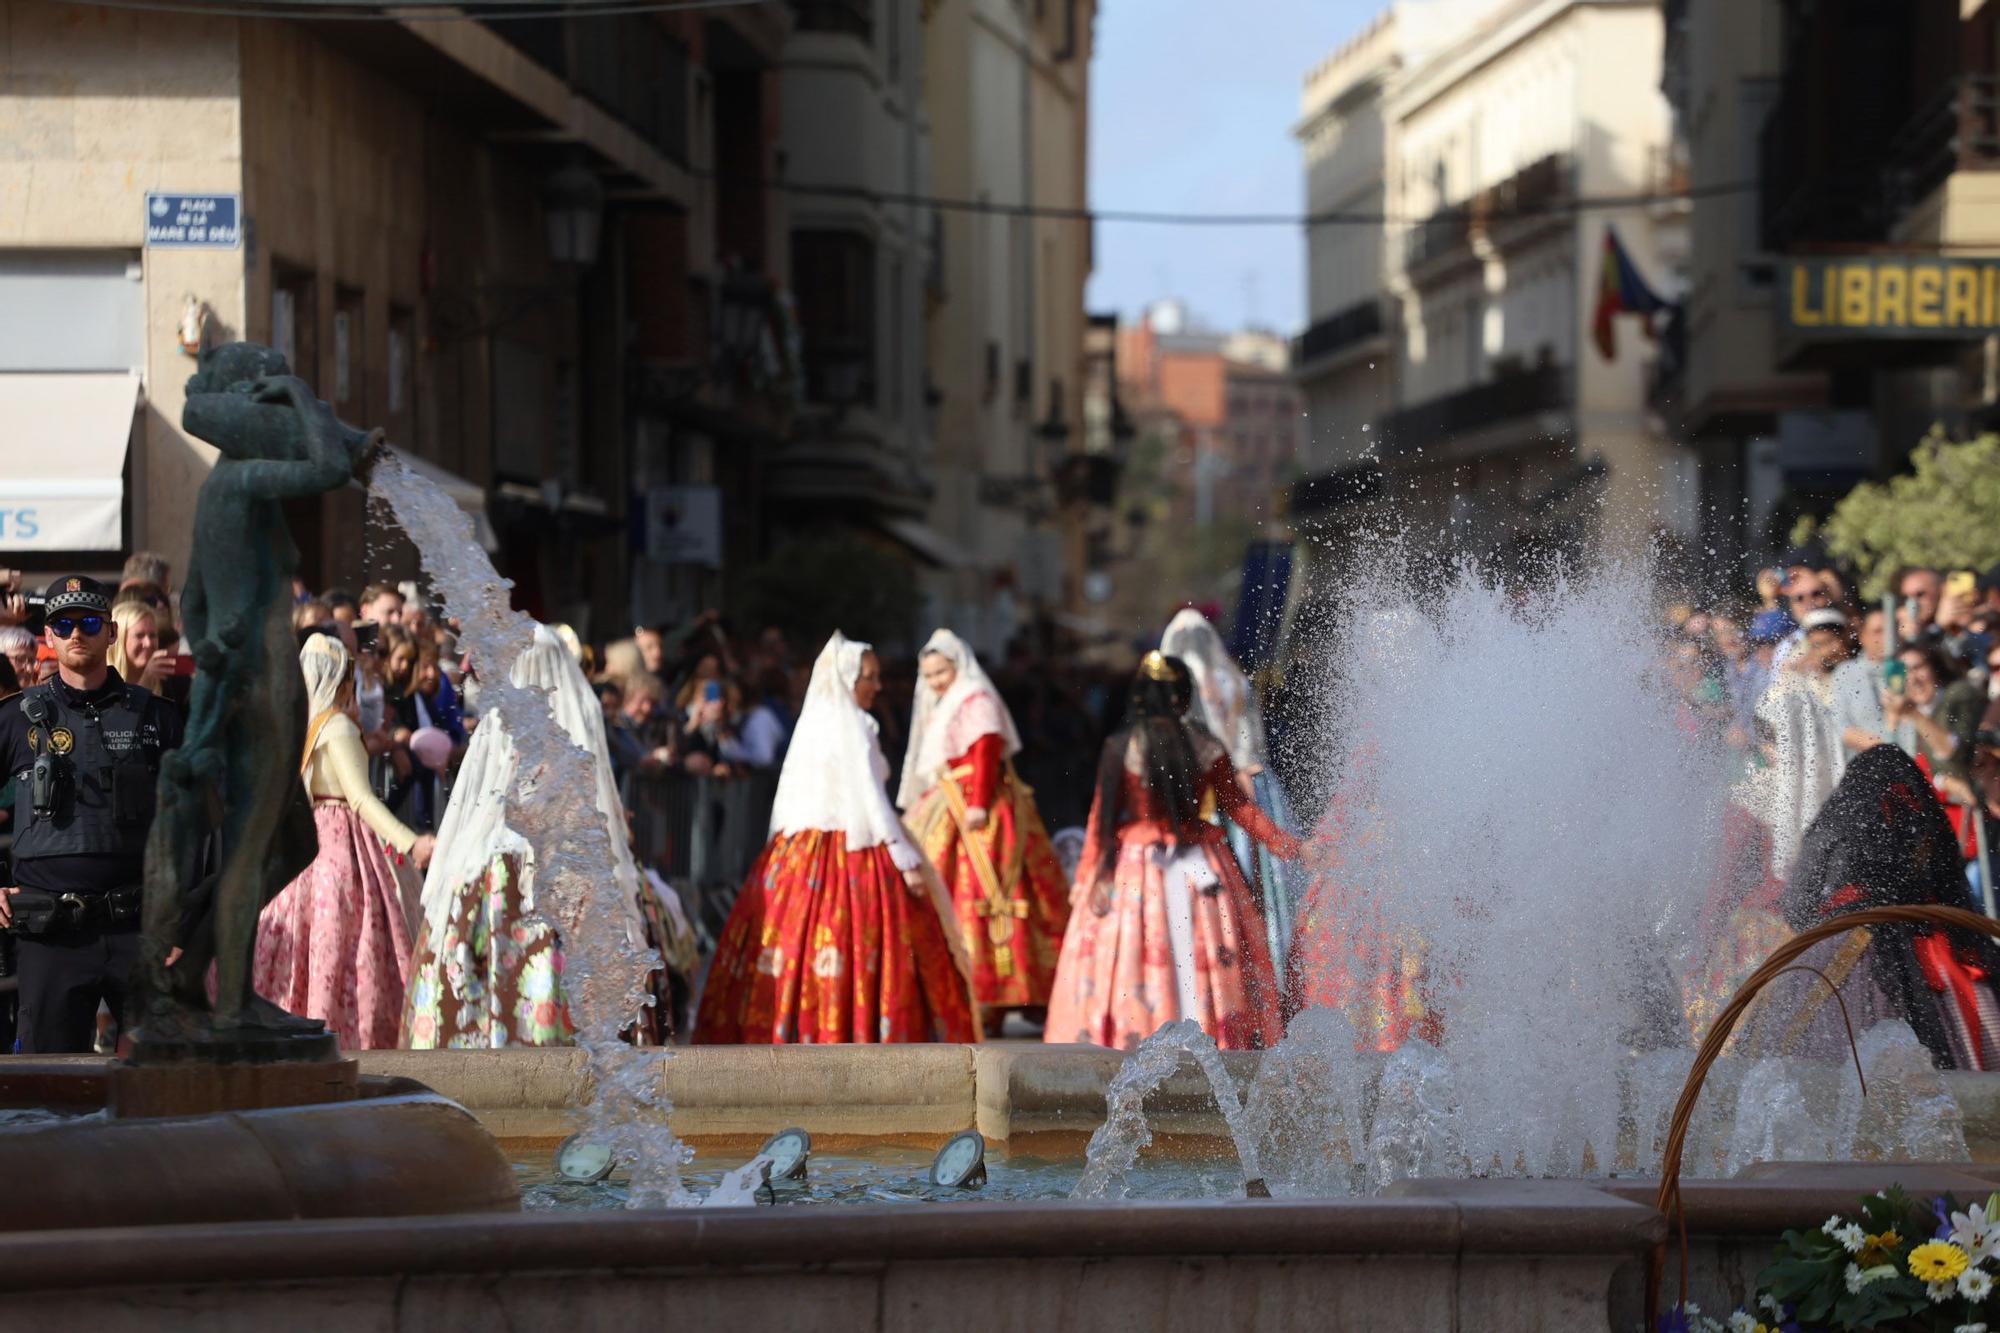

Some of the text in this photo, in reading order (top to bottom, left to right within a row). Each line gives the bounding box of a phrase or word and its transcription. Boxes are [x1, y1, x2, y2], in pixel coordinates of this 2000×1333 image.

[176, 213, 191, 225] DE
[150, 226, 186, 241] MARE
[188, 226, 207, 241] DE
